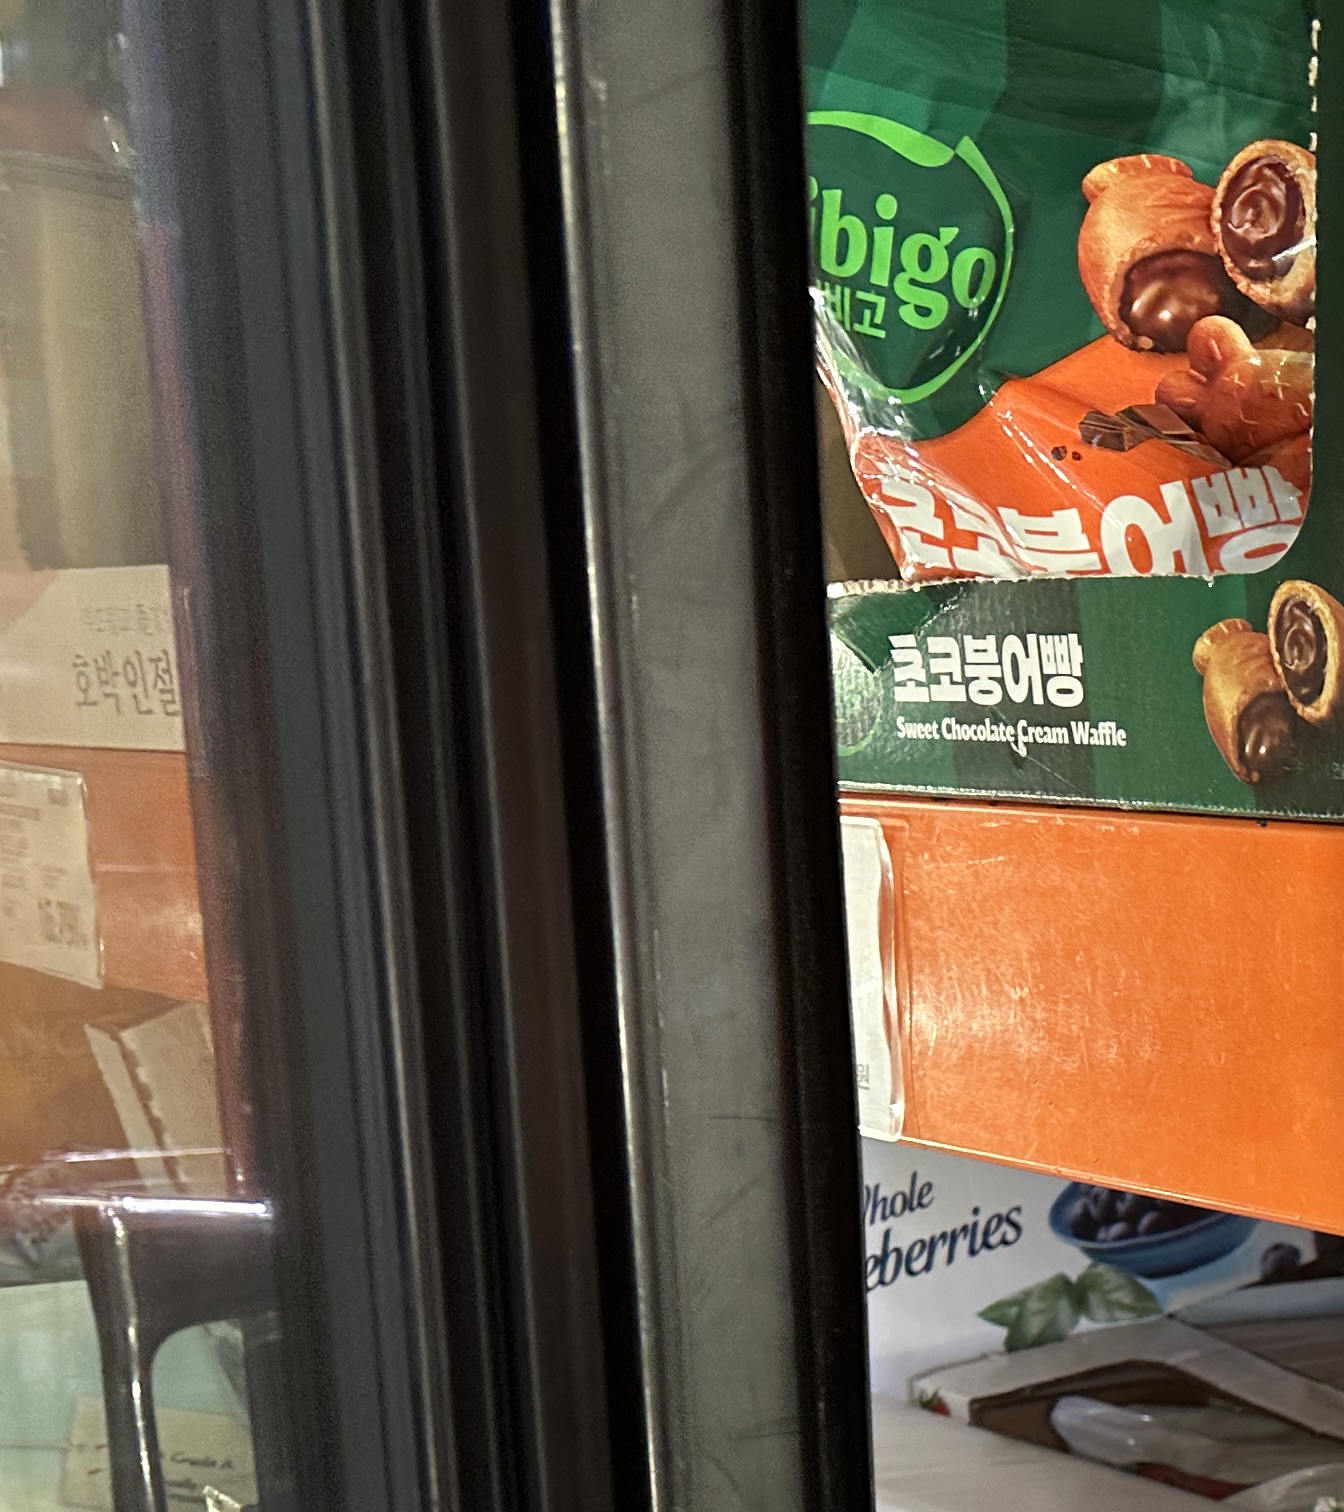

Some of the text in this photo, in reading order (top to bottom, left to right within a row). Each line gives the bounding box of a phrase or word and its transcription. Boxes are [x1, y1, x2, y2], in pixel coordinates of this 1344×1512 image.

[888, 632, 1085, 709] 초코붕어빵
[896, 716, 1127, 748] Sweet Chocolate Cream Waffle
